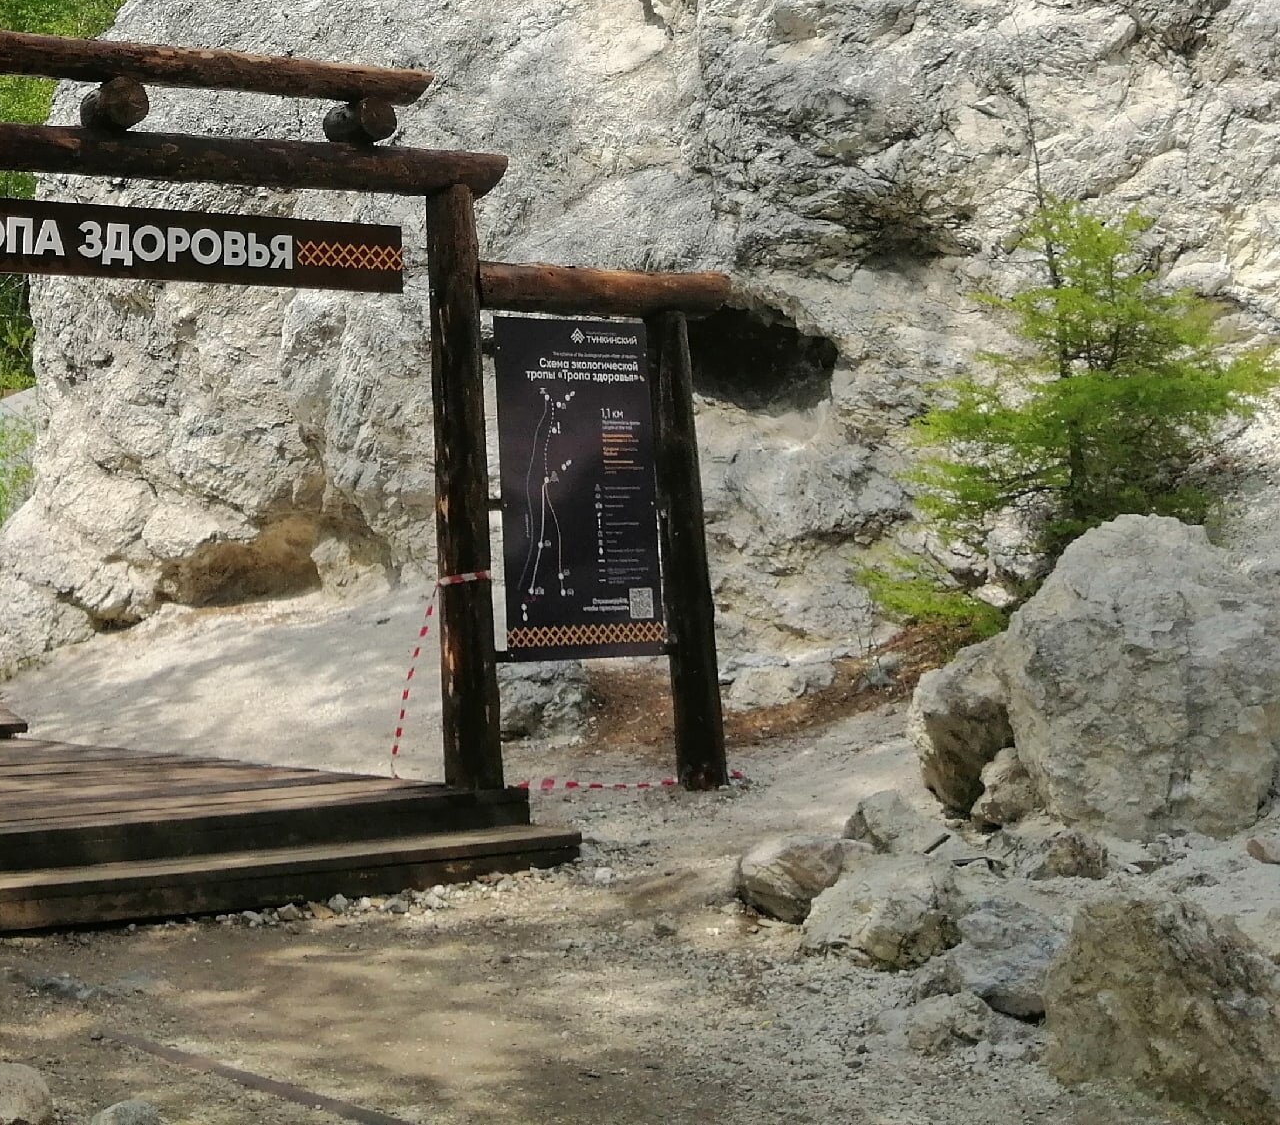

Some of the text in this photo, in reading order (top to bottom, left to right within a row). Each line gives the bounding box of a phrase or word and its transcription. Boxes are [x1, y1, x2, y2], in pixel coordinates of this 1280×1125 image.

[77, 221, 293, 269] ЗДОРОВЬЯ
[539, 357, 639, 372] Схема экологической
[525, 369, 639, 384] тропы «Тропа здоровья»
[600, 408, 624, 420] 1,1 км
